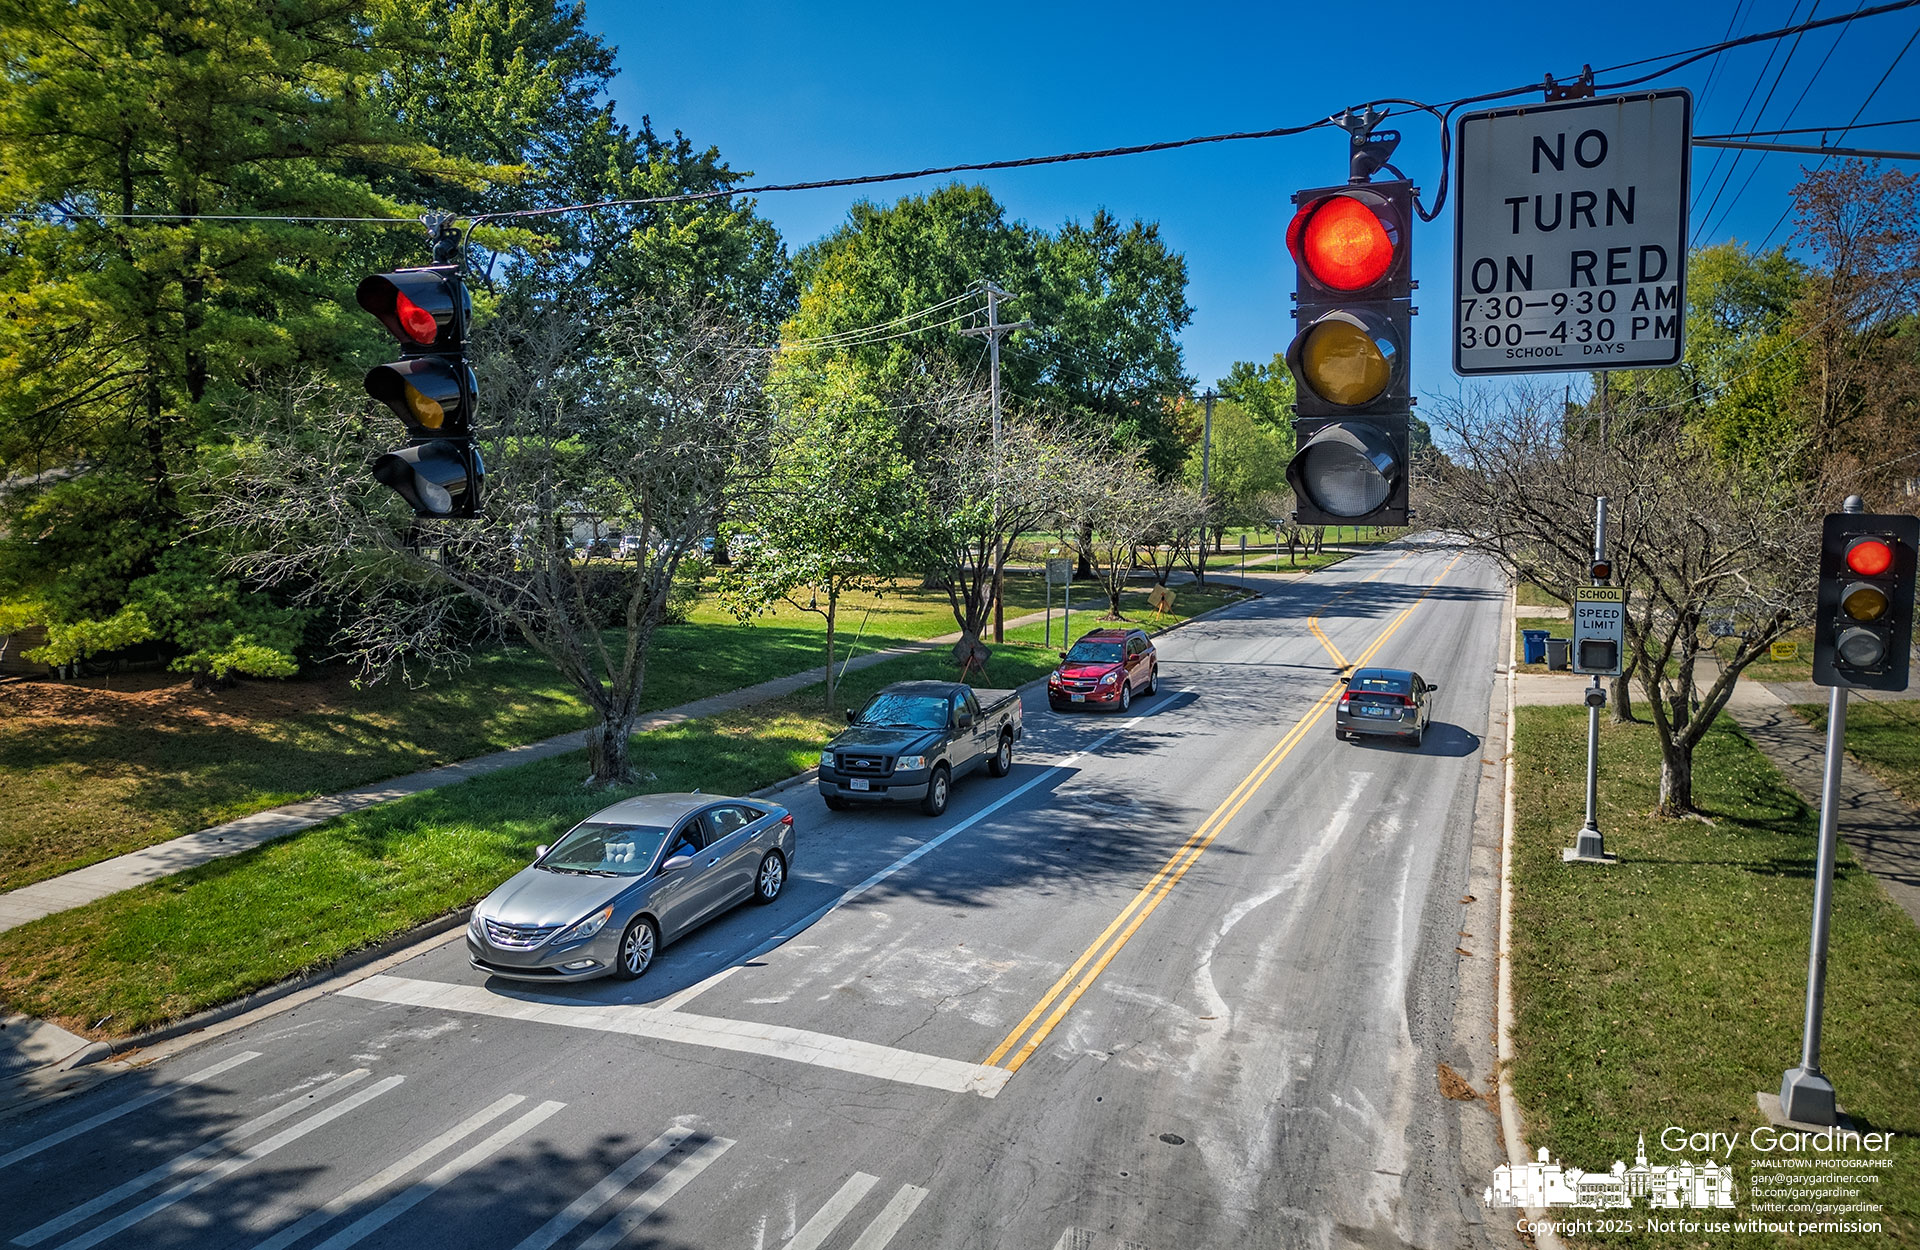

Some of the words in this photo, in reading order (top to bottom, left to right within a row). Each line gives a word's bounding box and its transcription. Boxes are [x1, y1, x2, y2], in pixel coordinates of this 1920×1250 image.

[1531, 129, 1608, 174] NO
[1504, 186, 1636, 234] TURN
[1471, 254, 1533, 294] ON
[1570, 245, 1668, 288] RED
[1630, 285, 1677, 311] AM
[1631, 315, 1675, 340] PM
[1506, 346, 1563, 358] SCHOOL
[1583, 343, 1625, 355] DAYS
[1579, 590, 1620, 600] SCHOOL
[1578, 608, 1620, 619] SPEED
[1583, 620, 1616, 630] LIMIT
